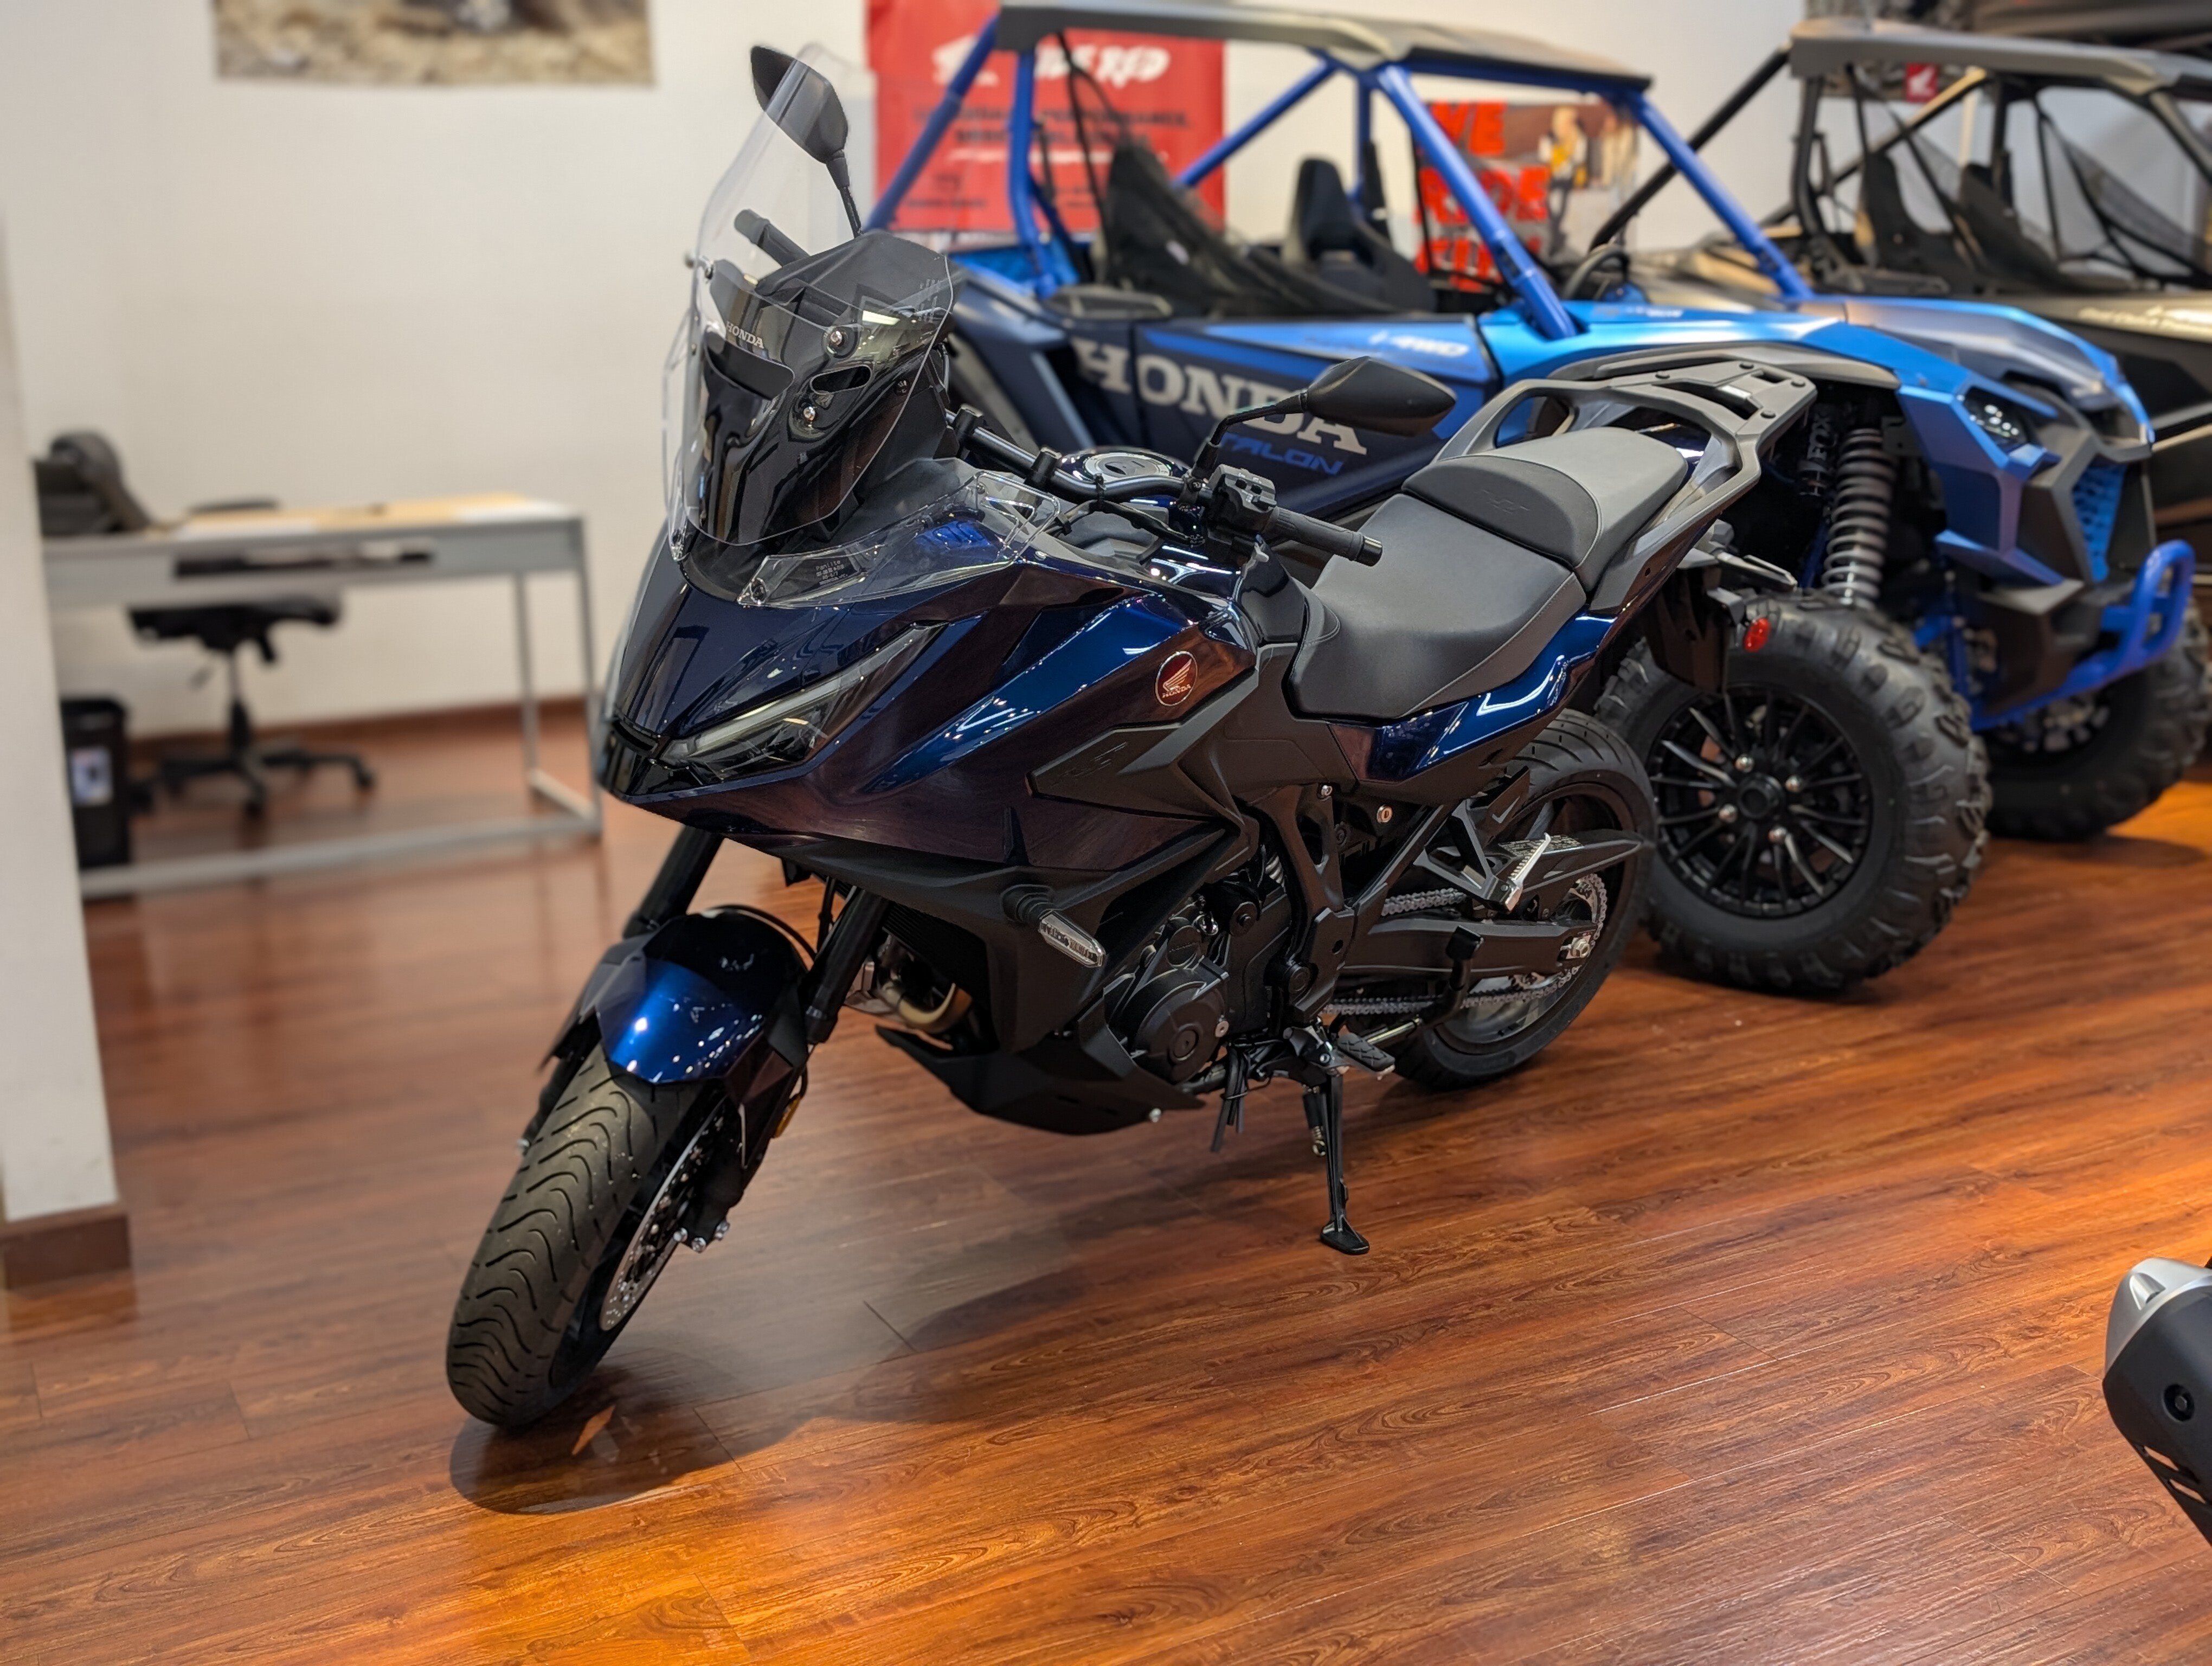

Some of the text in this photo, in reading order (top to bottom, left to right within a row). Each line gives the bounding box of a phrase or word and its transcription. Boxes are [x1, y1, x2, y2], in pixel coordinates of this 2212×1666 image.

[726, 321, 764, 349] HONDA
[1220, 432, 1343, 475] TALON
[1162, 684, 1192, 699] HONDA
